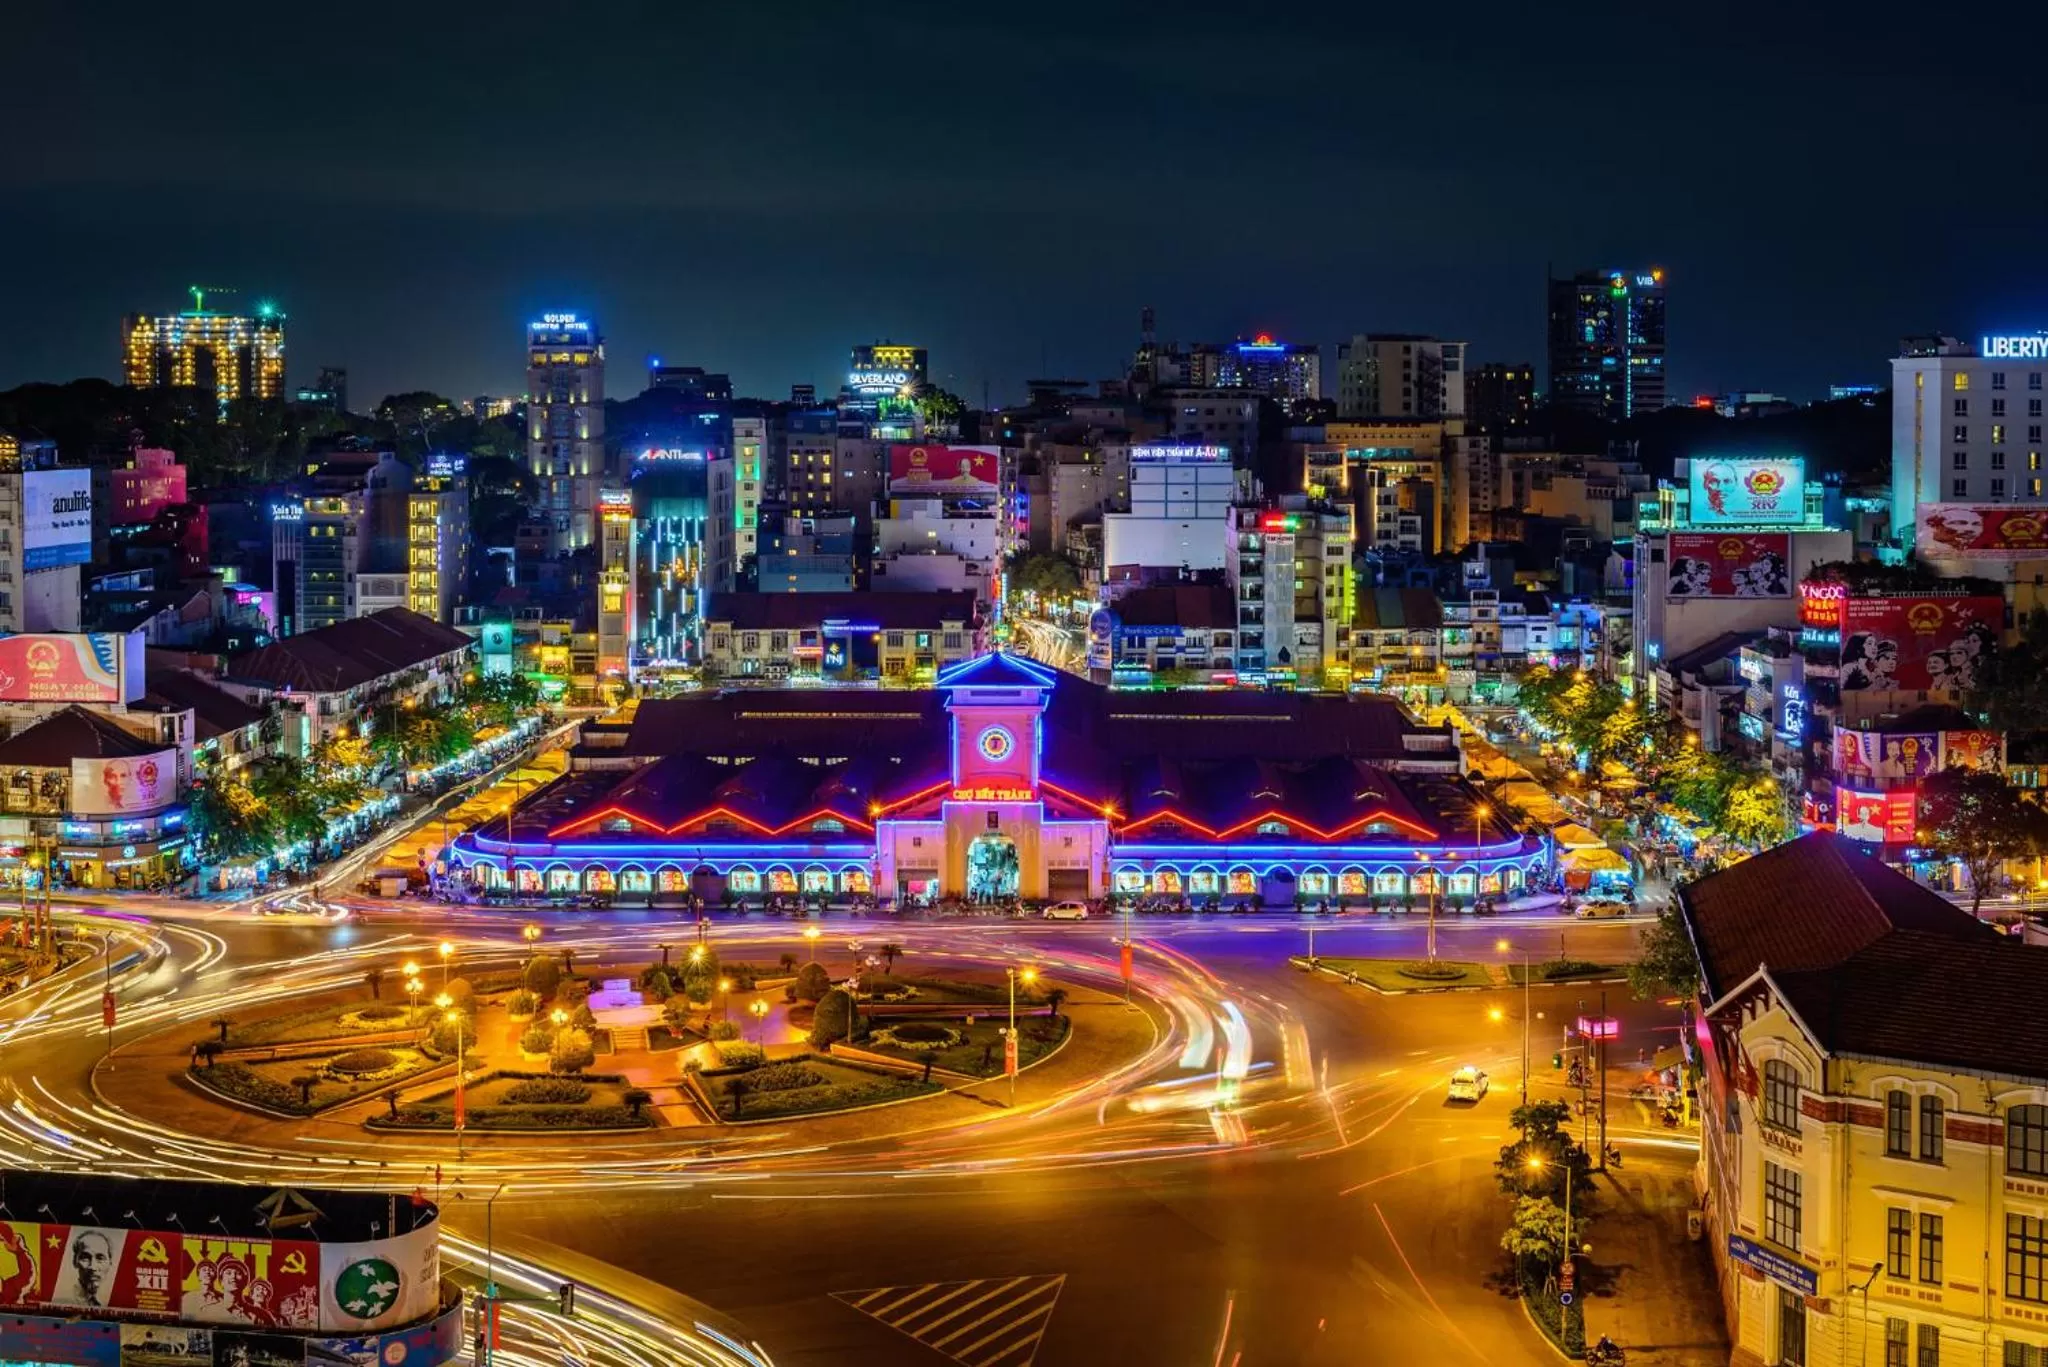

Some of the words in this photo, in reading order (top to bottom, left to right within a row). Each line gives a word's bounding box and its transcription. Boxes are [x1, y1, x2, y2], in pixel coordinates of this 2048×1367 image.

[1636, 275, 1654, 286] VIB
[543, 313, 576, 323] GOLDEN
[1983, 336, 2048, 358] LIBERTY
[848, 373, 907, 384] SILVERLAND
[1751, 499, 1779, 510] XIV
[825, 653, 843, 666] PNJ
[136, 1275, 169, 1290] XII
